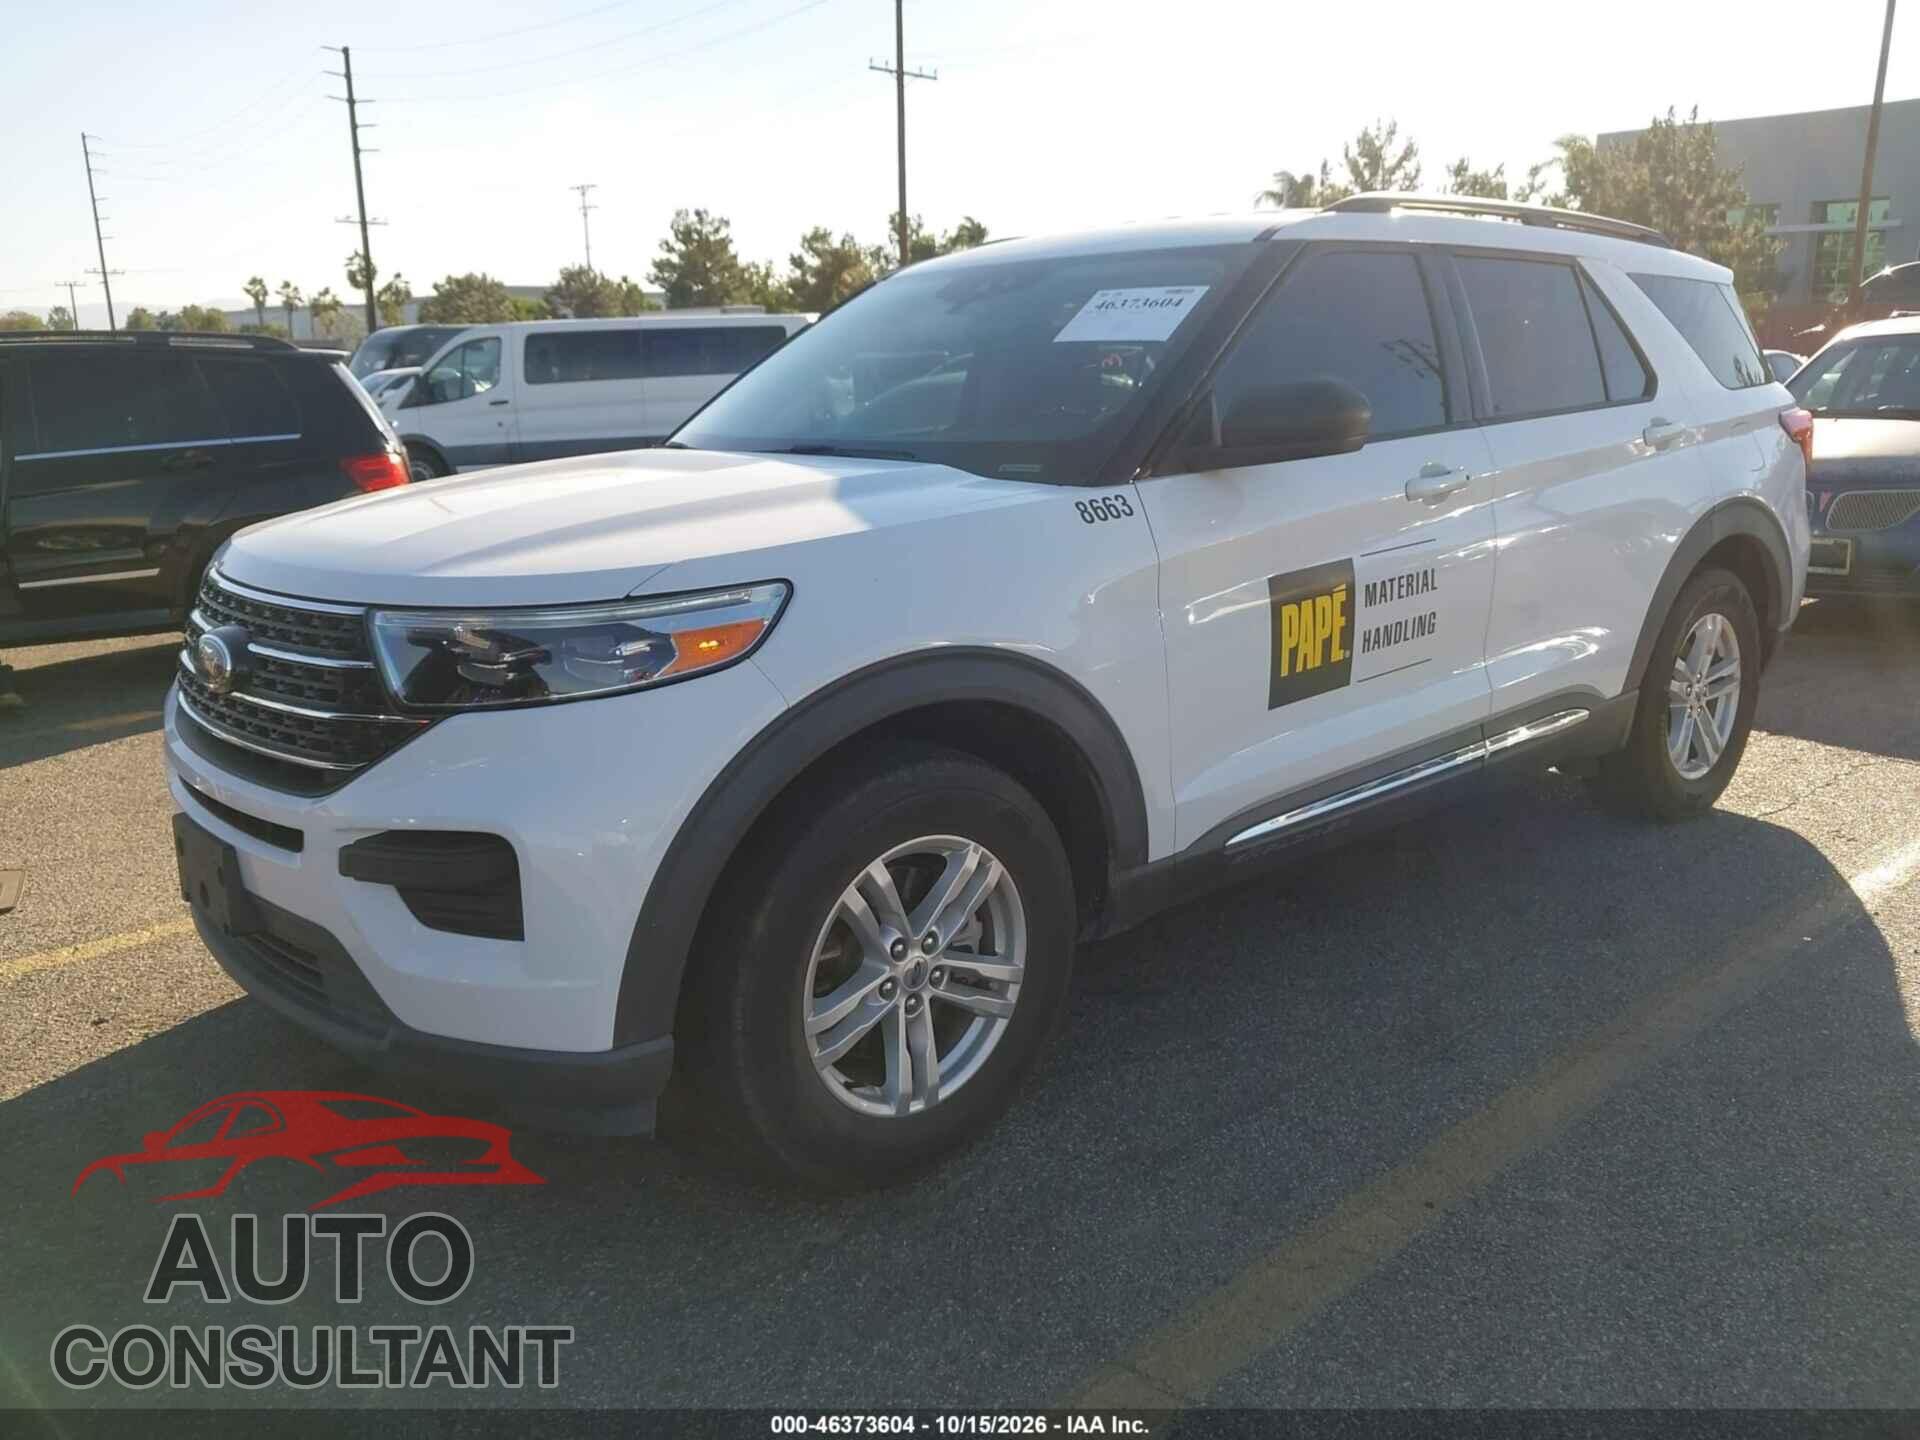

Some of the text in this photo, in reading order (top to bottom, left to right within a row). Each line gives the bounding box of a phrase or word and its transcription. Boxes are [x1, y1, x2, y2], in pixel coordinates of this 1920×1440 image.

[1075, 495, 1134, 524] 8663
[1365, 568, 1438, 608] MATERIAL
[1280, 583, 1347, 677] PAPÉ
[1362, 611, 1437, 654] HANDLING
